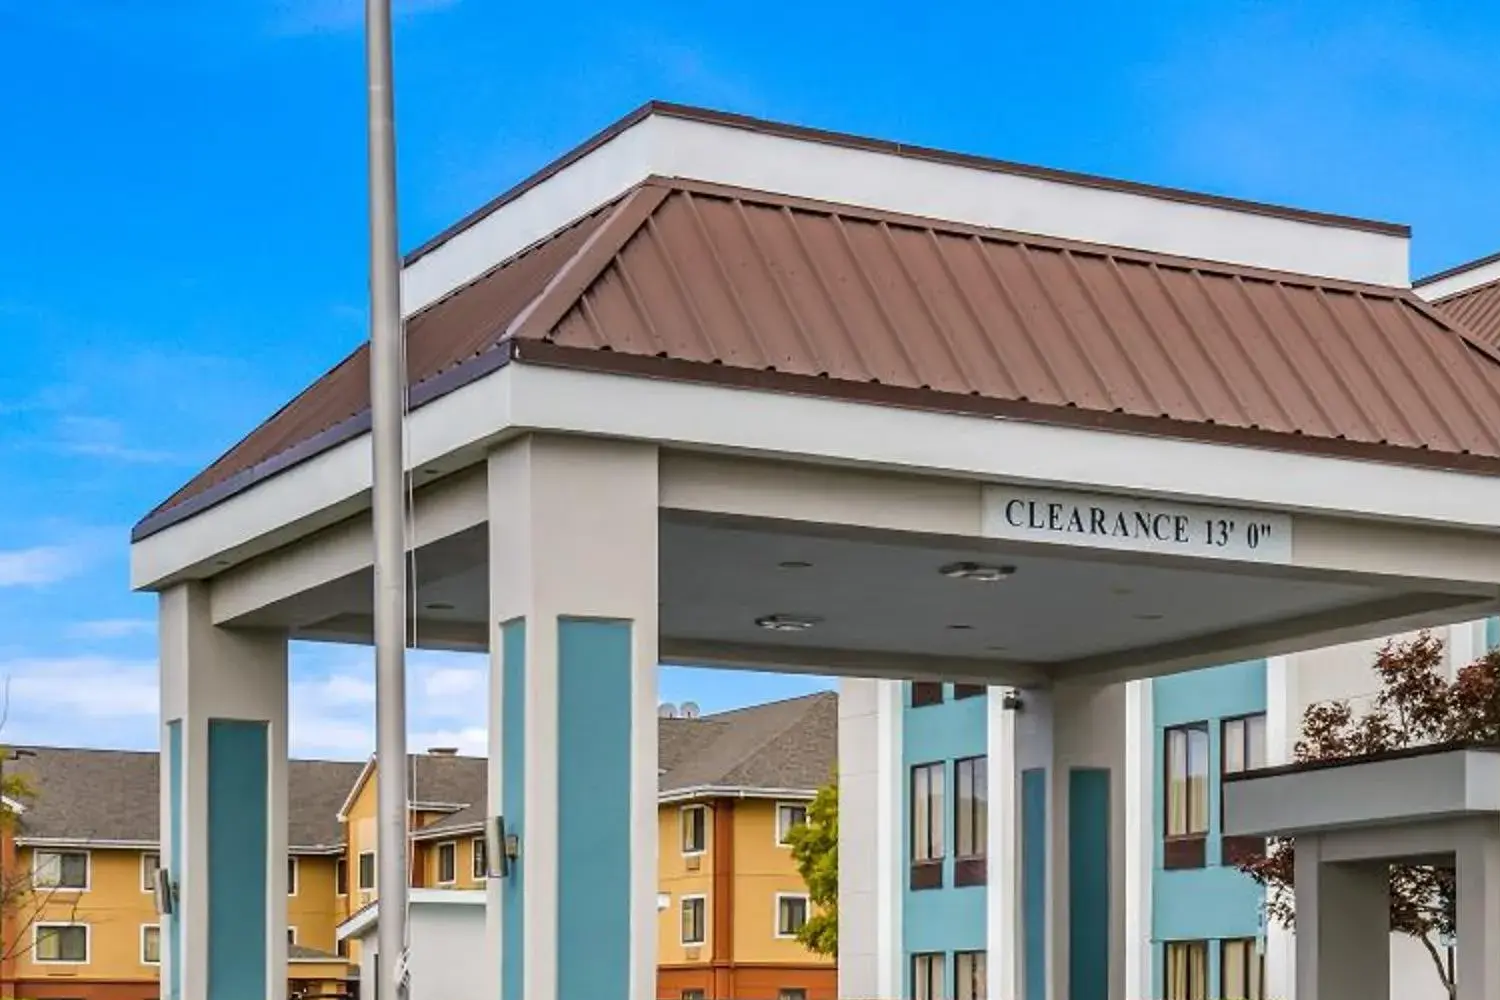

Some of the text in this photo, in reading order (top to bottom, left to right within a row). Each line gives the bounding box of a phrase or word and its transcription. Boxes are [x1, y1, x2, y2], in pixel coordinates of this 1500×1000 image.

[1005, 499, 1272, 549] CLEARANCE 13' 0"
